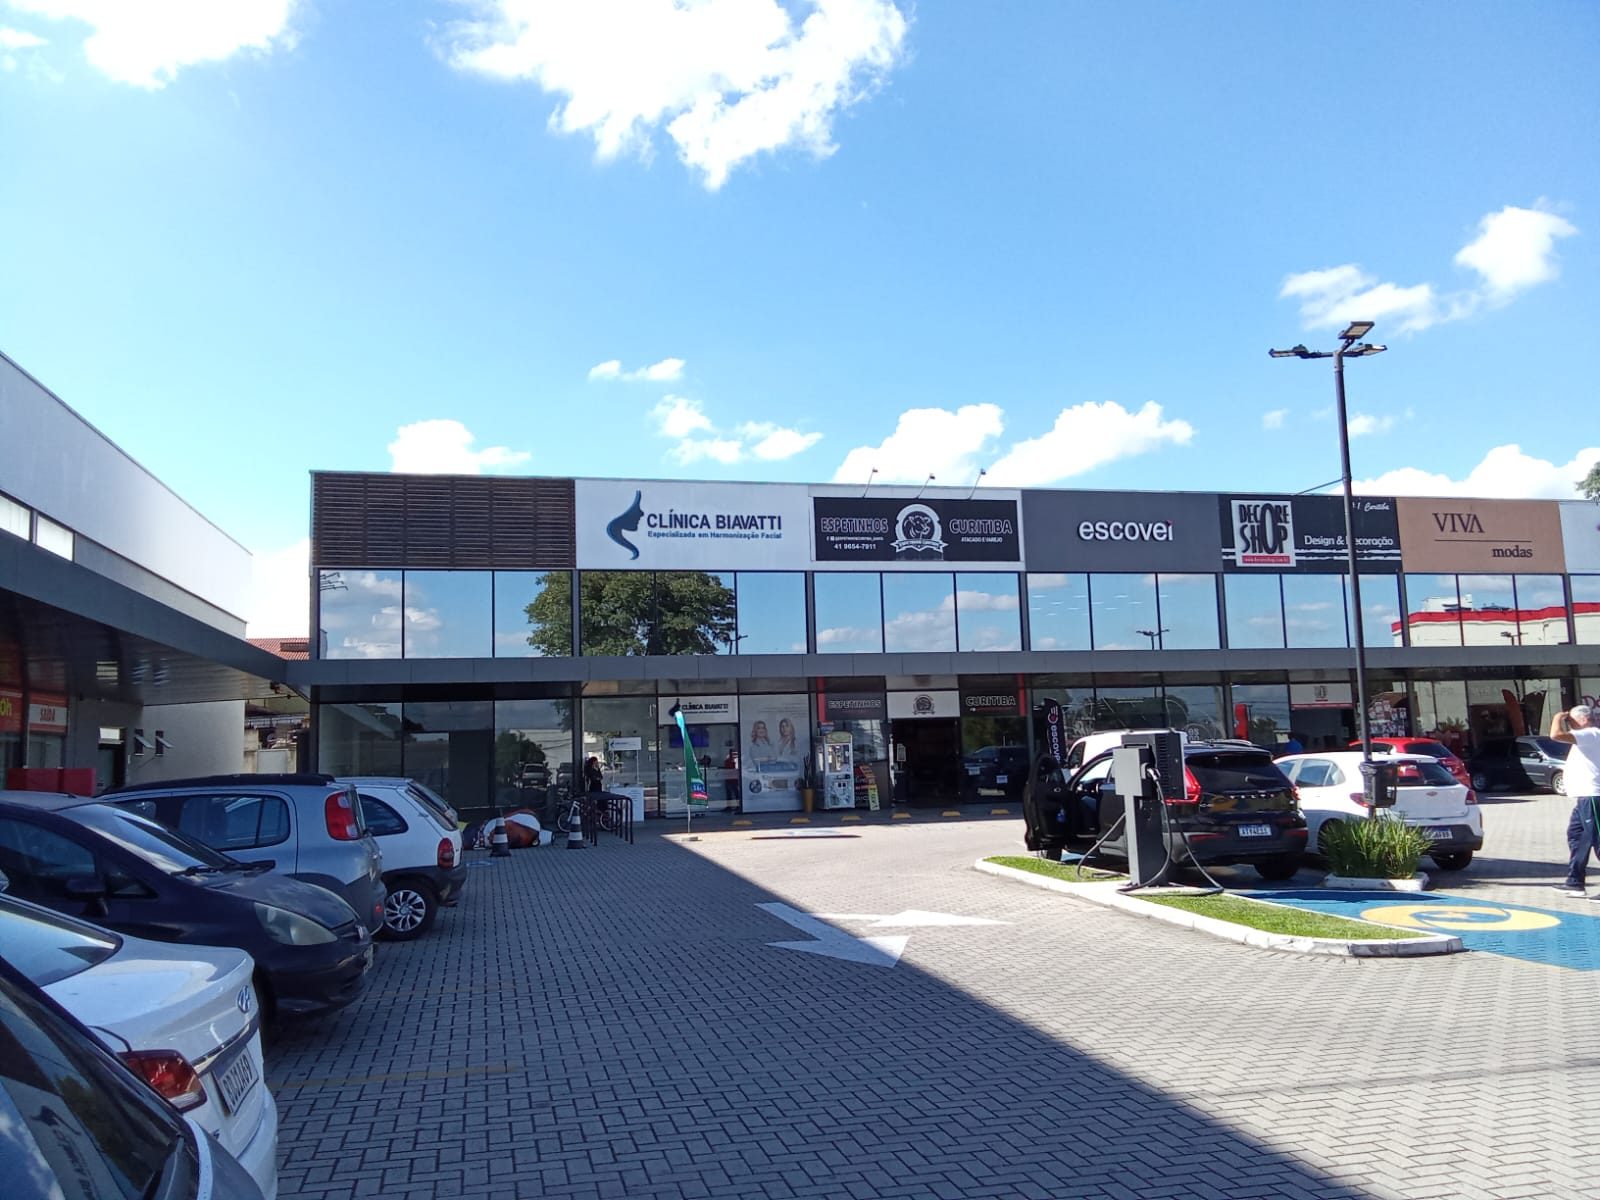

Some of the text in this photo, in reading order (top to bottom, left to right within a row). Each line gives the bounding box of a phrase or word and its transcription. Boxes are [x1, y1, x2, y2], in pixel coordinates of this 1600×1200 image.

[647, 509, 782, 530] CLÍNICA BIAVATTI
[821, 518, 889, 533] ESPETINHOS
[949, 519, 1013, 534] CURITIBA
[1432, 512, 1485, 533] VIVA
[710, 532, 760, 540] Harmonização
[1079, 519, 1174, 541] escovei
[1304, 535, 1335, 547] Design
[1336, 536, 1345, 546] &
[1492, 545, 1533, 558] modas
[966, 695, 1016, 706] CURITIBA
